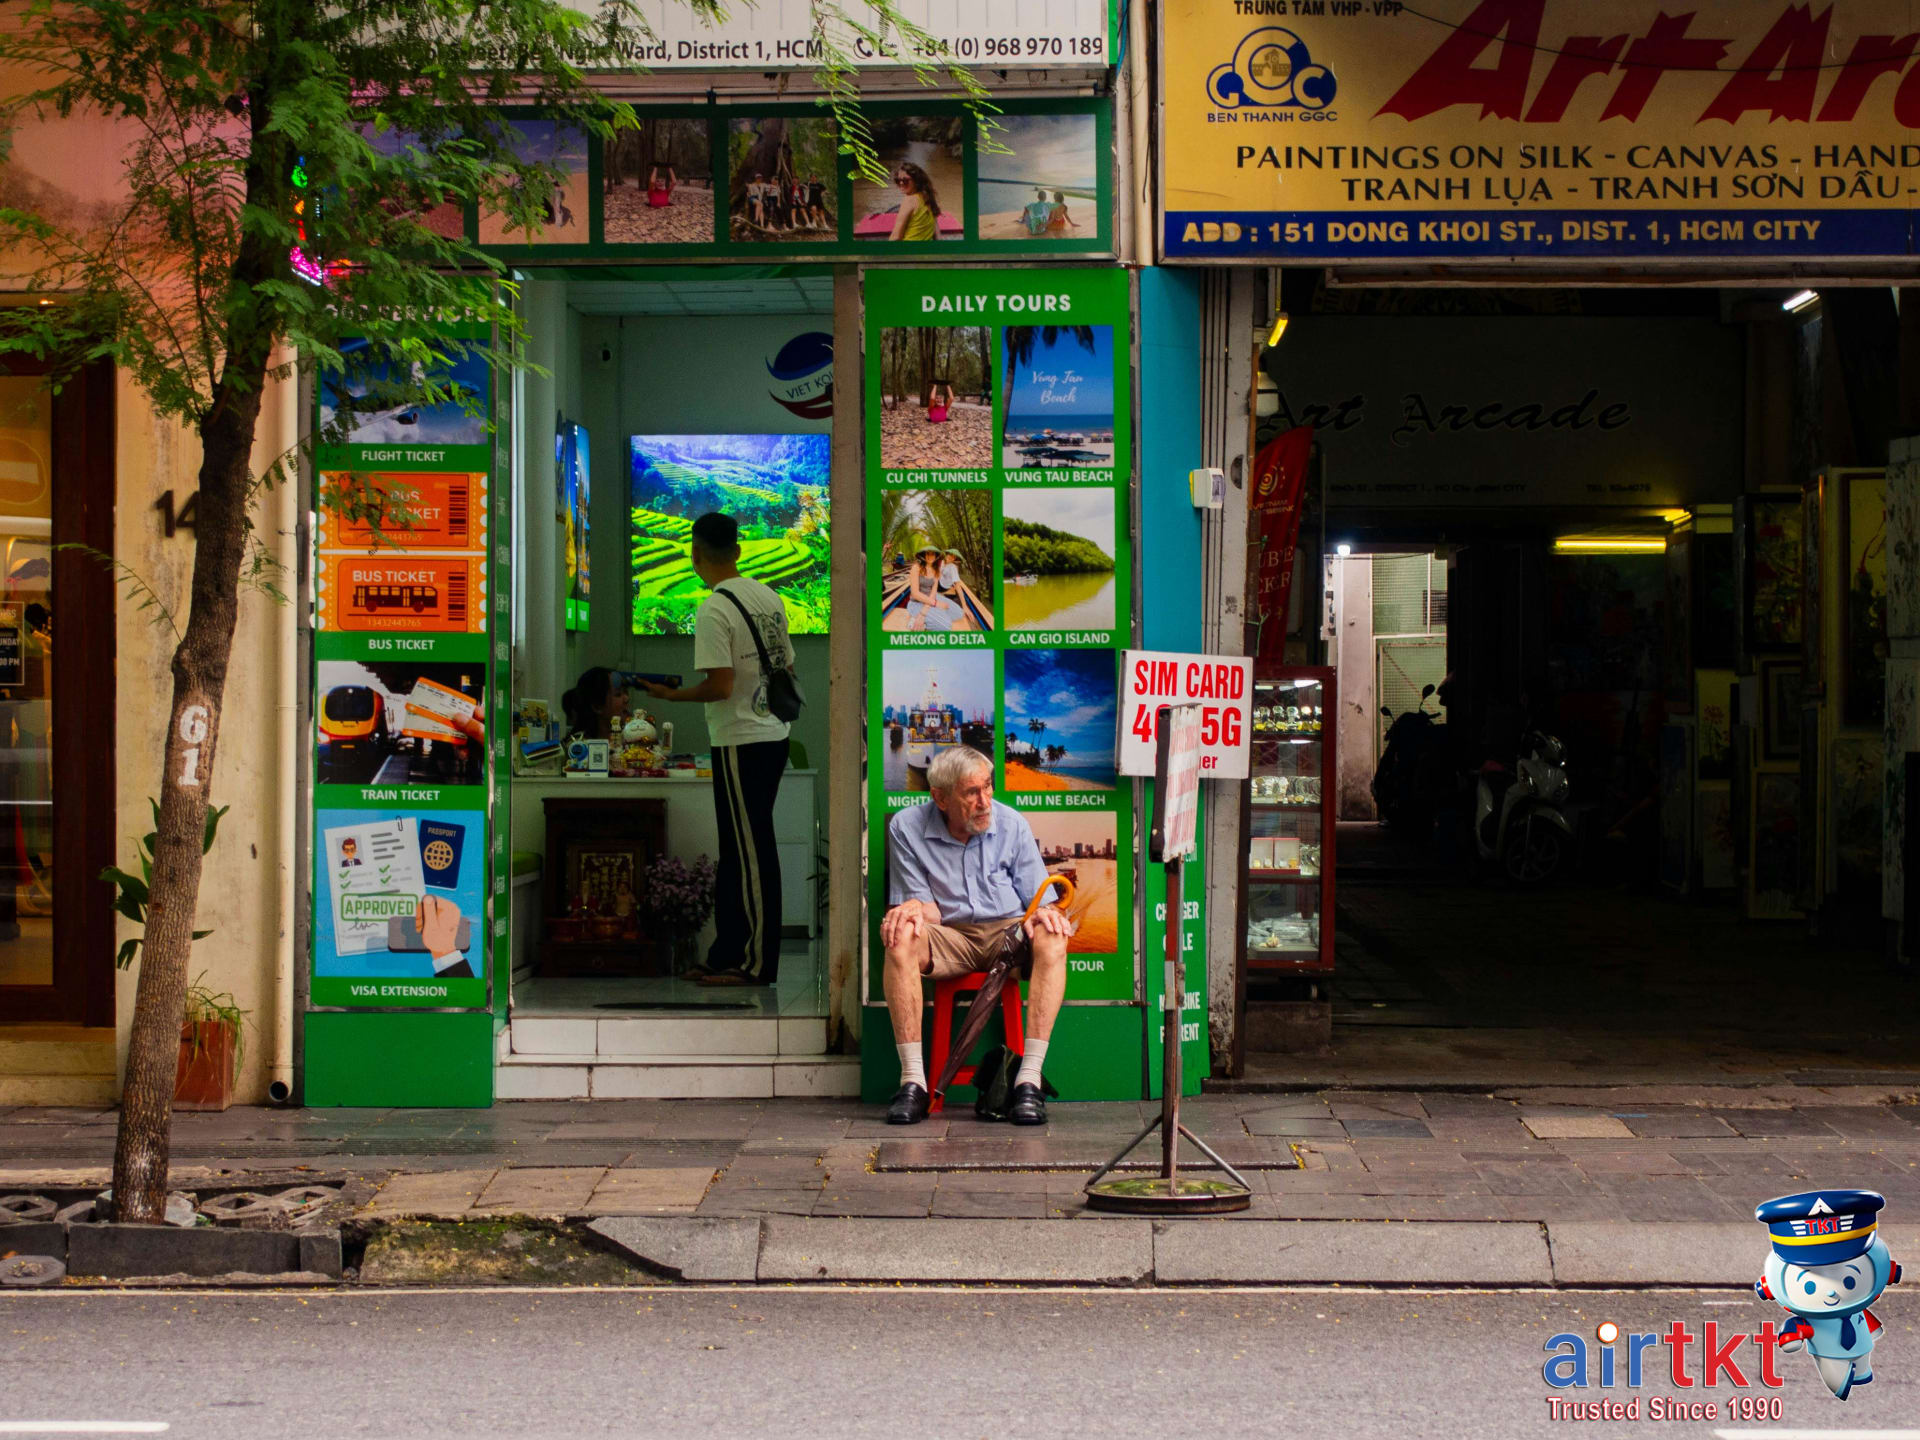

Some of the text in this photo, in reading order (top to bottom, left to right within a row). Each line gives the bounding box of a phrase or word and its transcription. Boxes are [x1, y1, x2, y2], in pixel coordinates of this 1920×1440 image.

[1234, 0, 1287, 15] TRUNG
[1330, 1, 1361, 16] VHP
[616, 40, 673, 62] Ward,
[677, 40, 749, 60] District
[755, 41, 771, 61] 1,
[777, 40, 823, 59] HCM
[955, 37, 979, 59] (0)
[985, 38, 1020, 56] 968
[1026, 38, 1062, 56] 970
[1069, 37, 1102, 55] 189
[1368, 0, 1735, 123] Art
[1207, 111, 1338, 123] BEN THANH GGC
[1236, 145, 1440, 169] PAINTINGS
[1449, 145, 1503, 169] ON
[1519, 144, 1593, 169] SILK
[1626, 145, 1778, 169] CANVAS
[1341, 178, 1471, 201] TRANH
[1484, 178, 1553, 206] LỤA
[1589, 177, 1718, 200] TRANH
[1732, 173, 1804, 198] SƠN
[1182, 222, 1242, 243] ADD
[1268, 222, 1315, 242] 151
[1327, 222, 1409, 242] DONG
[1419, 221, 1490, 242] KHOI
[1500, 221, 1552, 246] ST.,
[1562, 220, 1636, 242] DIST.
[1647, 220, 1671, 245] 1,
[1680, 219, 1744, 241] HCM
[1752, 220, 1821, 241] CITY
[921, 294, 1072, 313] DAILY TOURS
[786, 381, 811, 399] VIET
[1391, 387, 1633, 448] Arcade
[361, 450, 446, 462] FLIGHT TICKET
[886, 471, 988, 483] CU CHI TUNNELS
[1005, 471, 1113, 483] VUNG TAU BEACH
[352, 570, 436, 583] BUS TICKET
[368, 638, 436, 650] BUS TICKET
[890, 633, 986, 646] MEKONG DELTA
[1010, 633, 1110, 645] CAN GIO ISLAND
[1134, 660, 1244, 699] SIM CARD
[1201, 706, 1242, 747] 5G
[361, 789, 441, 801] TRAIN TICKET
[1016, 795, 1106, 806] MUI NE BEACH
[427, 826, 457, 838] PASSPORT
[344, 898, 415, 915] APPROVED
[1070, 960, 1104, 971] TOUR
[351, 985, 447, 997] VISA EXTENSION
